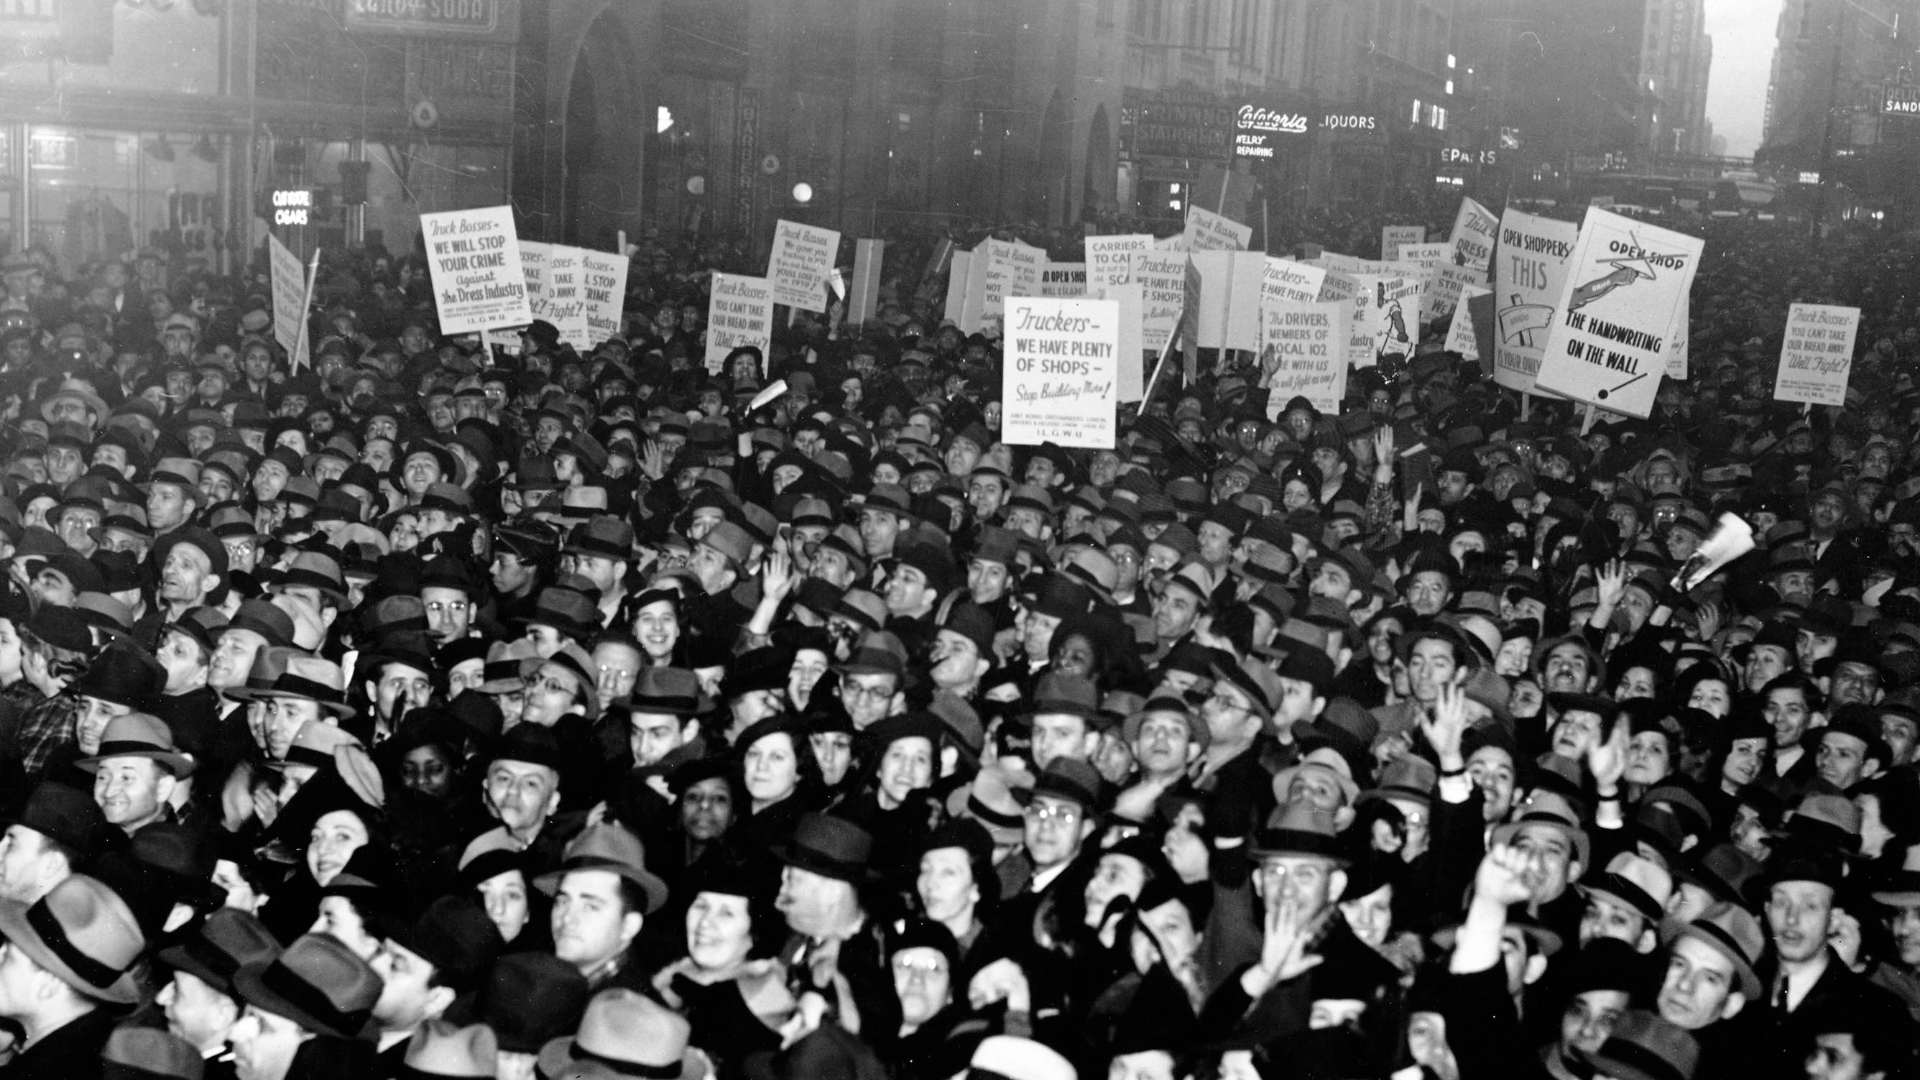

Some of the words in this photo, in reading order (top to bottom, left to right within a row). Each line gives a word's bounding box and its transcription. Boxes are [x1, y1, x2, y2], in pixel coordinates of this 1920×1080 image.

[1886, 101, 1920, 113] SAND
[1237, 146, 1273, 157] REPAIRING
[430, 219, 456, 236] Truck
[434, 241, 450, 255] WE
[451, 238, 476, 254] WILL
[478, 235, 505, 250] STOP
[1503, 228, 1522, 248] OPEN
[1093, 241, 1146, 251] CARRIERS
[1456, 238, 1489, 259] DRESS
[1094, 254, 1109, 264] TO
[1407, 250, 1419, 258] WE
[1421, 250, 1440, 258] CAN
[1609, 240, 1646, 259] OPEN
[1650, 252, 1684, 271] SHOP
[439, 256, 469, 273] YOUR
[470, 252, 506, 269] CRIME
[554, 274, 574, 284] TAKE
[1051, 271, 1069, 283] OPEN
[1442, 269, 1454, 279] WE
[1457, 272, 1475, 284] CAN
[1512, 255, 1547, 291] THIS
[593, 275, 616, 288] STOP
[1151, 277, 1169, 289] HAVE
[457, 287, 484, 301] Dress
[485, 282, 524, 299] Industry
[585, 287, 611, 303] RIME
[1042, 286, 1056, 295] WILL
[1058, 286, 1082, 295] ESCAPE
[1268, 284, 1287, 297] HAVE
[715, 299, 727, 311] YOU
[749, 303, 765, 316] TAKE
[712, 314, 726, 326] OUR
[727, 315, 747, 329] BREAD
[748, 319, 765, 332] AWAY
[1269, 329, 1311, 340] MEMBERS
[1314, 329, 1328, 340] OF
[1565, 310, 1586, 331] THE
[1588, 317, 1662, 353] HANDWRITING
[1792, 327, 1805, 337] YOU
[1829, 330, 1846, 341] TAKE
[1016, 338, 1036, 354] WE
[1039, 339, 1069, 356] HAVE
[1071, 341, 1113, 358] PLENTY
[1275, 343, 1306, 355] OCAL
[1310, 343, 1327, 355] 102
[1787, 340, 1802, 350] OUR
[1803, 341, 1826, 352] BREAD
[1827, 343, 1846, 353] AWAY
[1016, 357, 1036, 372] OF
[1504, 352, 1521, 369] YOUR
[1567, 339, 1584, 359] ON
[1585, 344, 1604, 366] THE
[1606, 351, 1638, 375] WALL
[1292, 360, 1314, 370] WITH
[1316, 361, 1329, 371] US
[1016, 383, 1038, 406] Stop
[1040, 382, 1082, 402] Building
